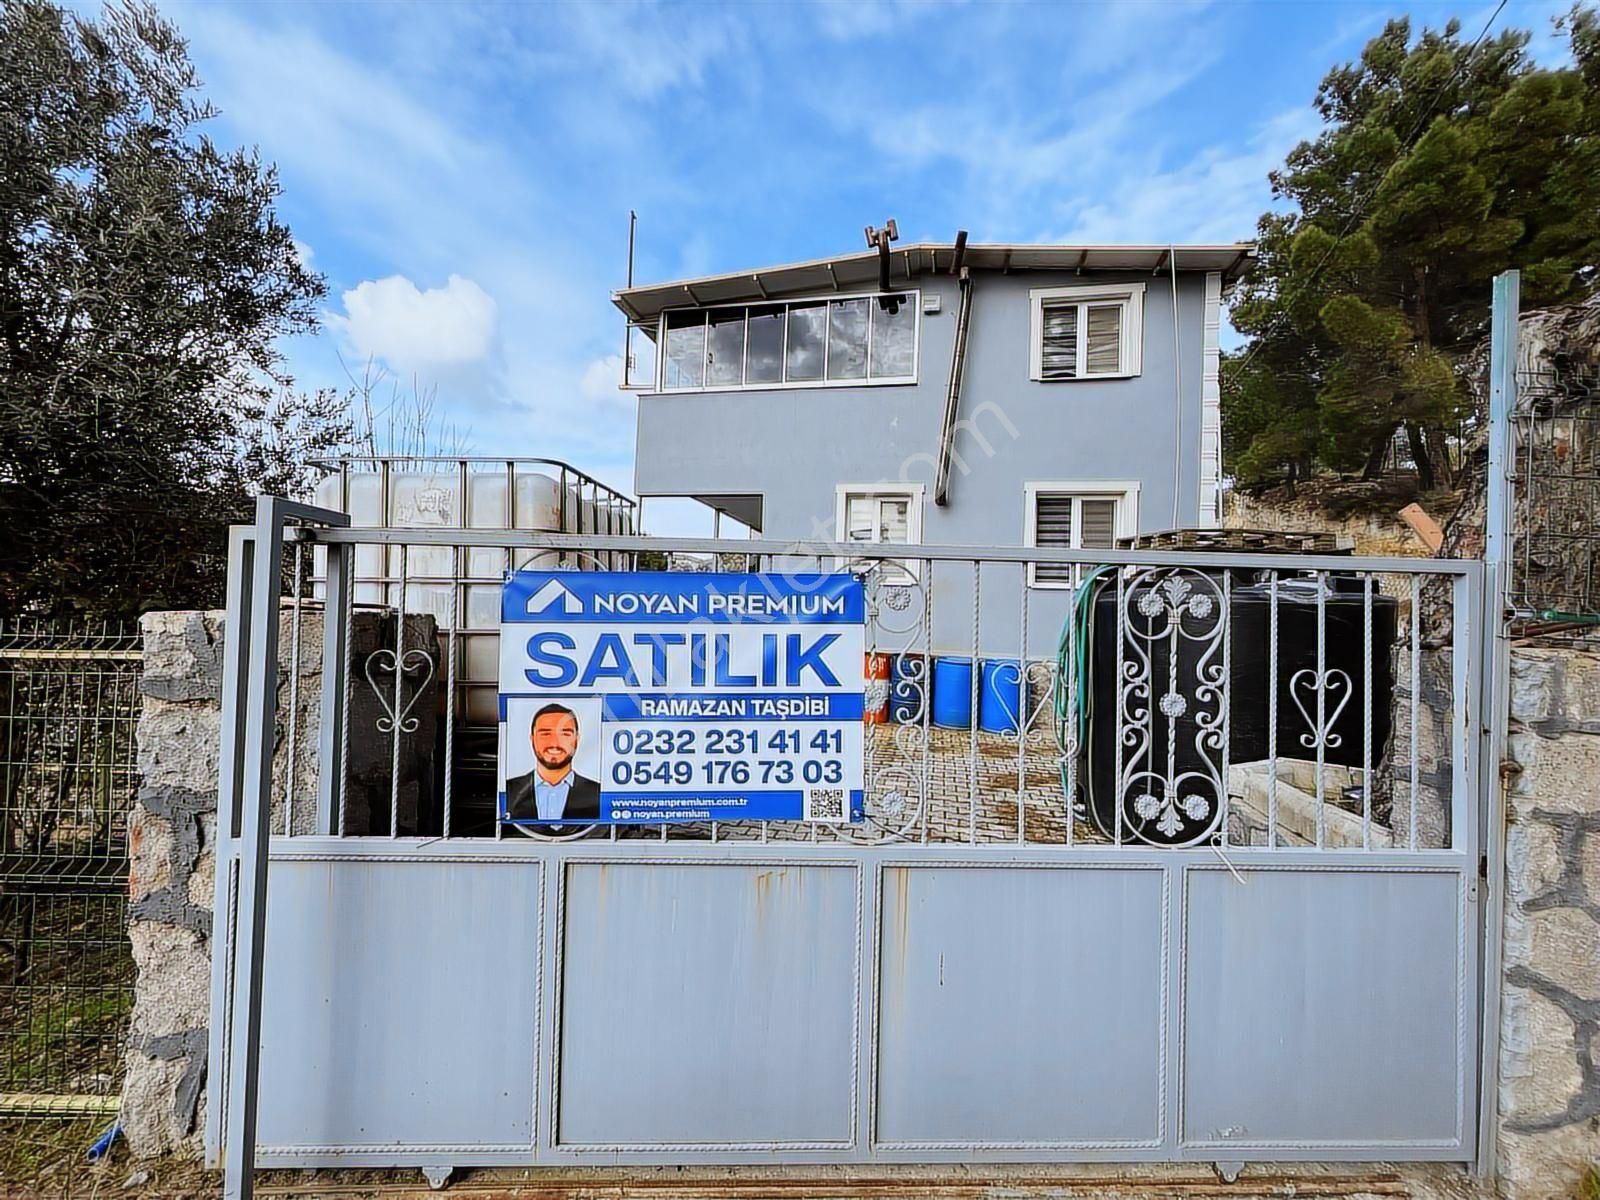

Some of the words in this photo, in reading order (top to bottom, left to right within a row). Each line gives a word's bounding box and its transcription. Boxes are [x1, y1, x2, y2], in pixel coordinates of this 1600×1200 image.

[594, 593, 698, 615] NOYAN
[708, 593, 844, 616] PREMIUM
[524, 632, 842, 688] SATILIK
[641, 699, 746, 716] RAMAZAN
[751, 696, 829, 720] TAŞDİBİ
[612, 729, 696, 755] 0232
[705, 729, 758, 754] 231
[768, 729, 801, 754] 41
[810, 728, 843, 754] 41
[612, 760, 693, 785] 0549
[702, 760, 750, 785] 176
[758, 760, 794, 784] 73
[803, 759, 843, 784] 03
[611, 797, 748, 808] www.noyanpremium.com.tr
[633, 809, 710, 819] noyan.premium
